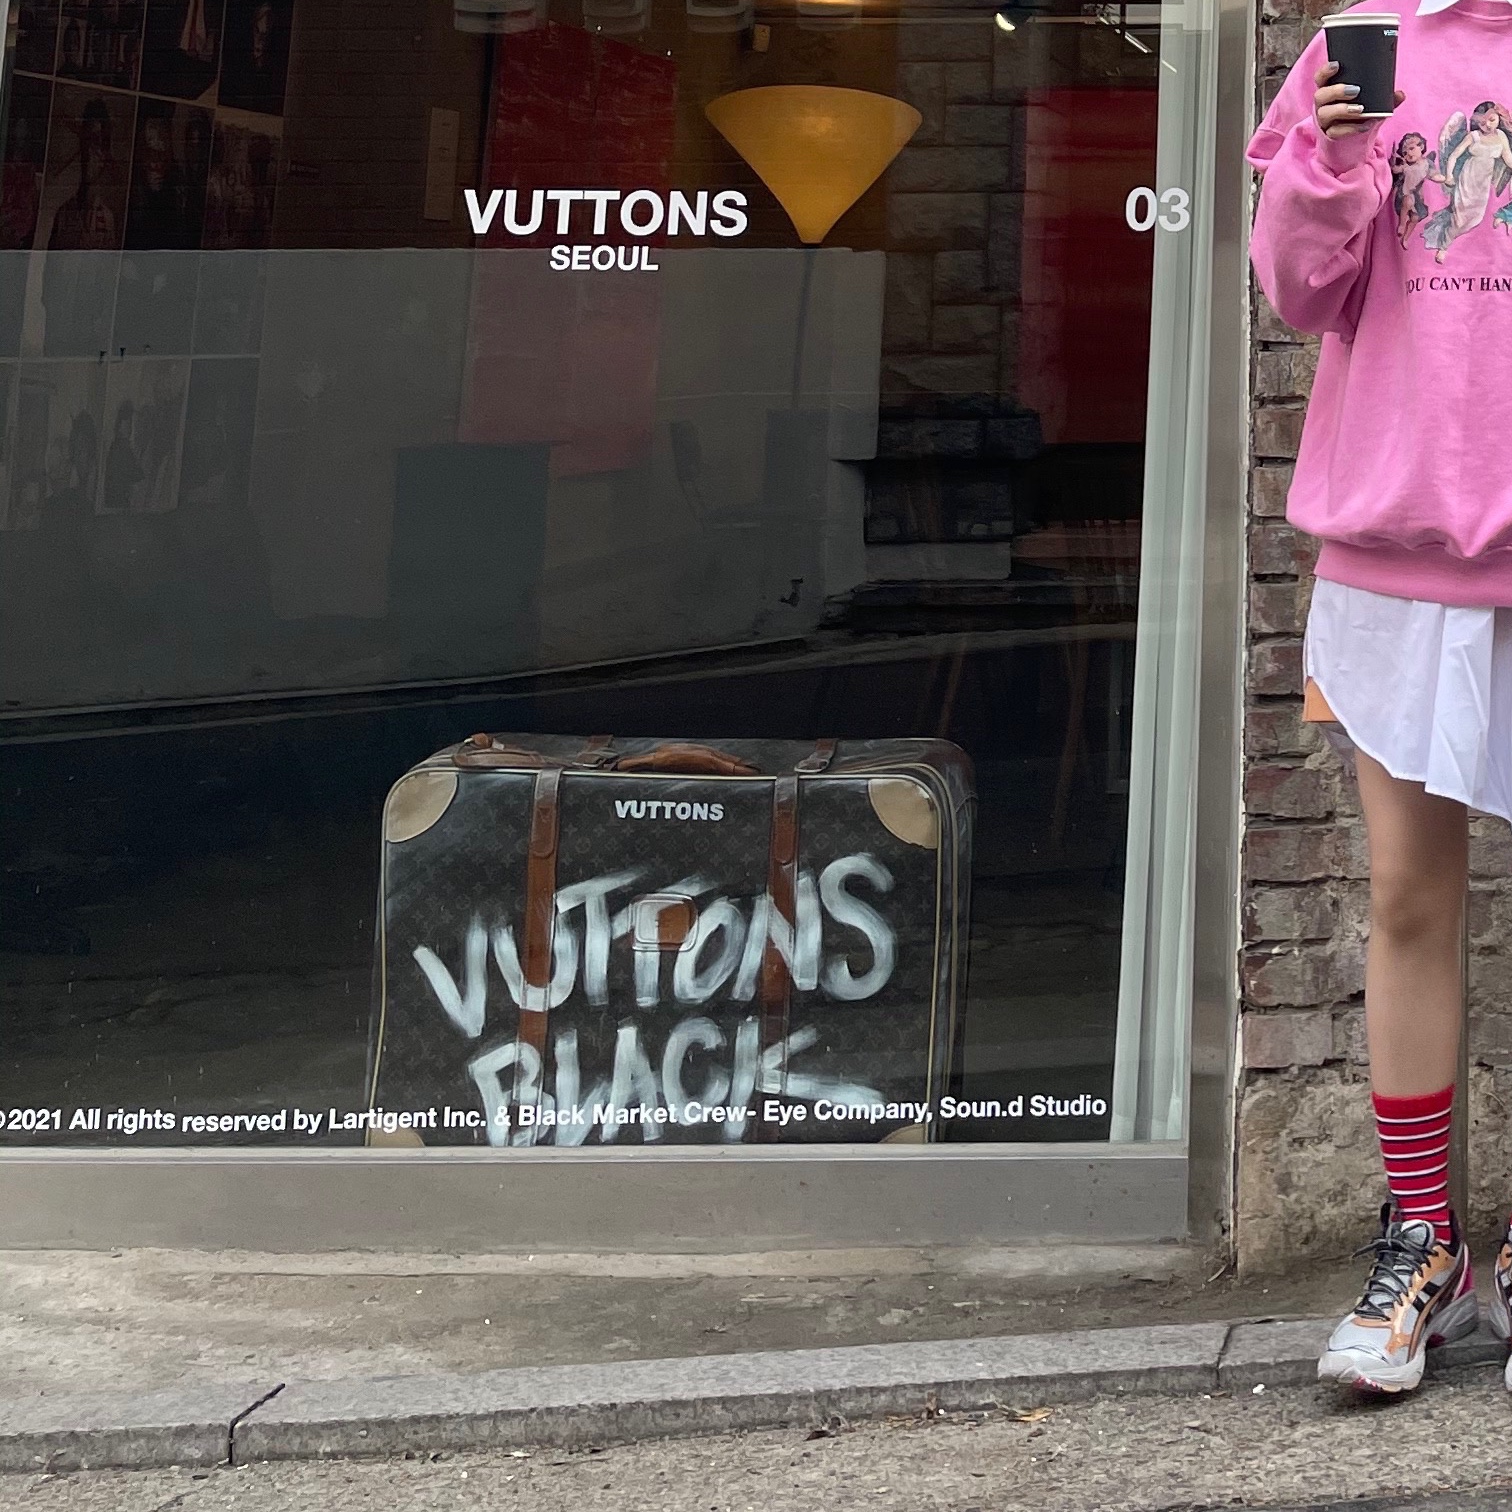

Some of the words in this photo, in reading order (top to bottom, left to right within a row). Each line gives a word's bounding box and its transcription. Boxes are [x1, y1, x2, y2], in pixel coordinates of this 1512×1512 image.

[464, 189, 747, 237] VUTTONS
[1126, 187, 1190, 231] 03
[550, 245, 659, 271] SEOUL
[1407, 278, 1425, 293] OU
[1430, 277, 1475, 290] CAN'T
[614, 800, 724, 821] VUTTONS
[412, 852, 895, 1038] VUTTONS
[468, 1017, 885, 1146] BLACK
[69, 1109, 100, 1131] All
[106, 1110, 175, 1135] rights
[182, 1110, 286, 1131] reserved
[292, 1109, 321, 1135] by
[328, 1108, 437, 1135] Lartigent
[443, 1108, 486, 1128] Inc.
[493, 1107, 511, 1126] &
[518, 1105, 584, 1126] Black
[593, 1102, 677, 1126] Market
[683, 1102, 757, 1124] Crew-
[763, 1101, 806, 1125] Eye
[814, 1100, 932, 1124] Company,
[940, 1096, 1023, 1119] Soun.d
[1030, 1094, 1106, 1117] Studio
